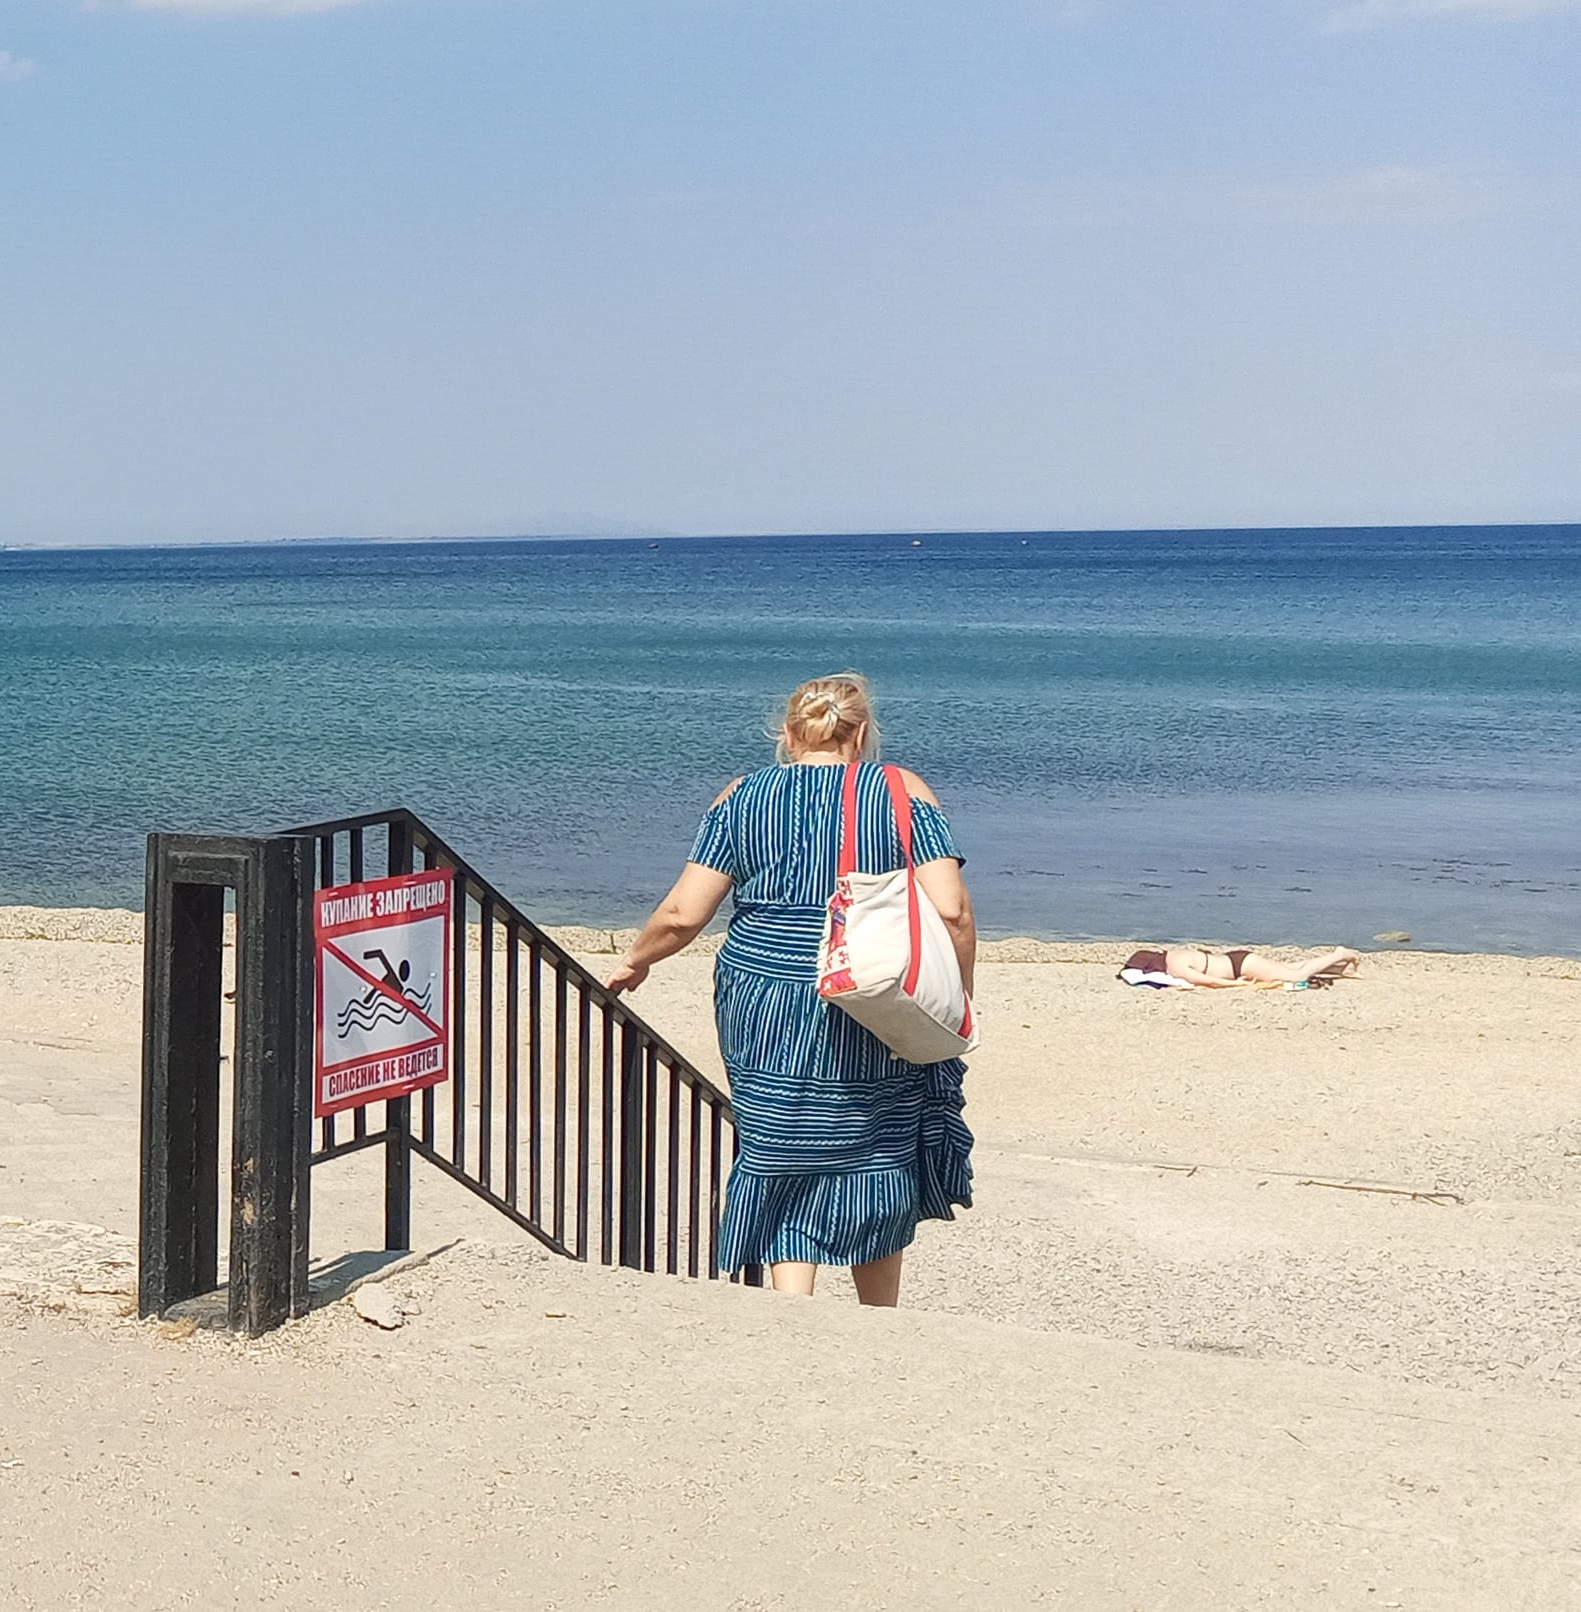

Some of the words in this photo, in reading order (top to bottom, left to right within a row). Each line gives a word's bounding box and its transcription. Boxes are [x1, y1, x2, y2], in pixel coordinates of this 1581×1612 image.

[321, 893, 374, 928] КУПАНИЕ
[376, 880, 446, 917] ЗАПРЕЩЕНО
[329, 1063, 381, 1097] СПАСЕНИЕ
[382, 1060, 397, 1081] НЕ
[398, 1047, 439, 1078] ВЕДЕТСЯ
